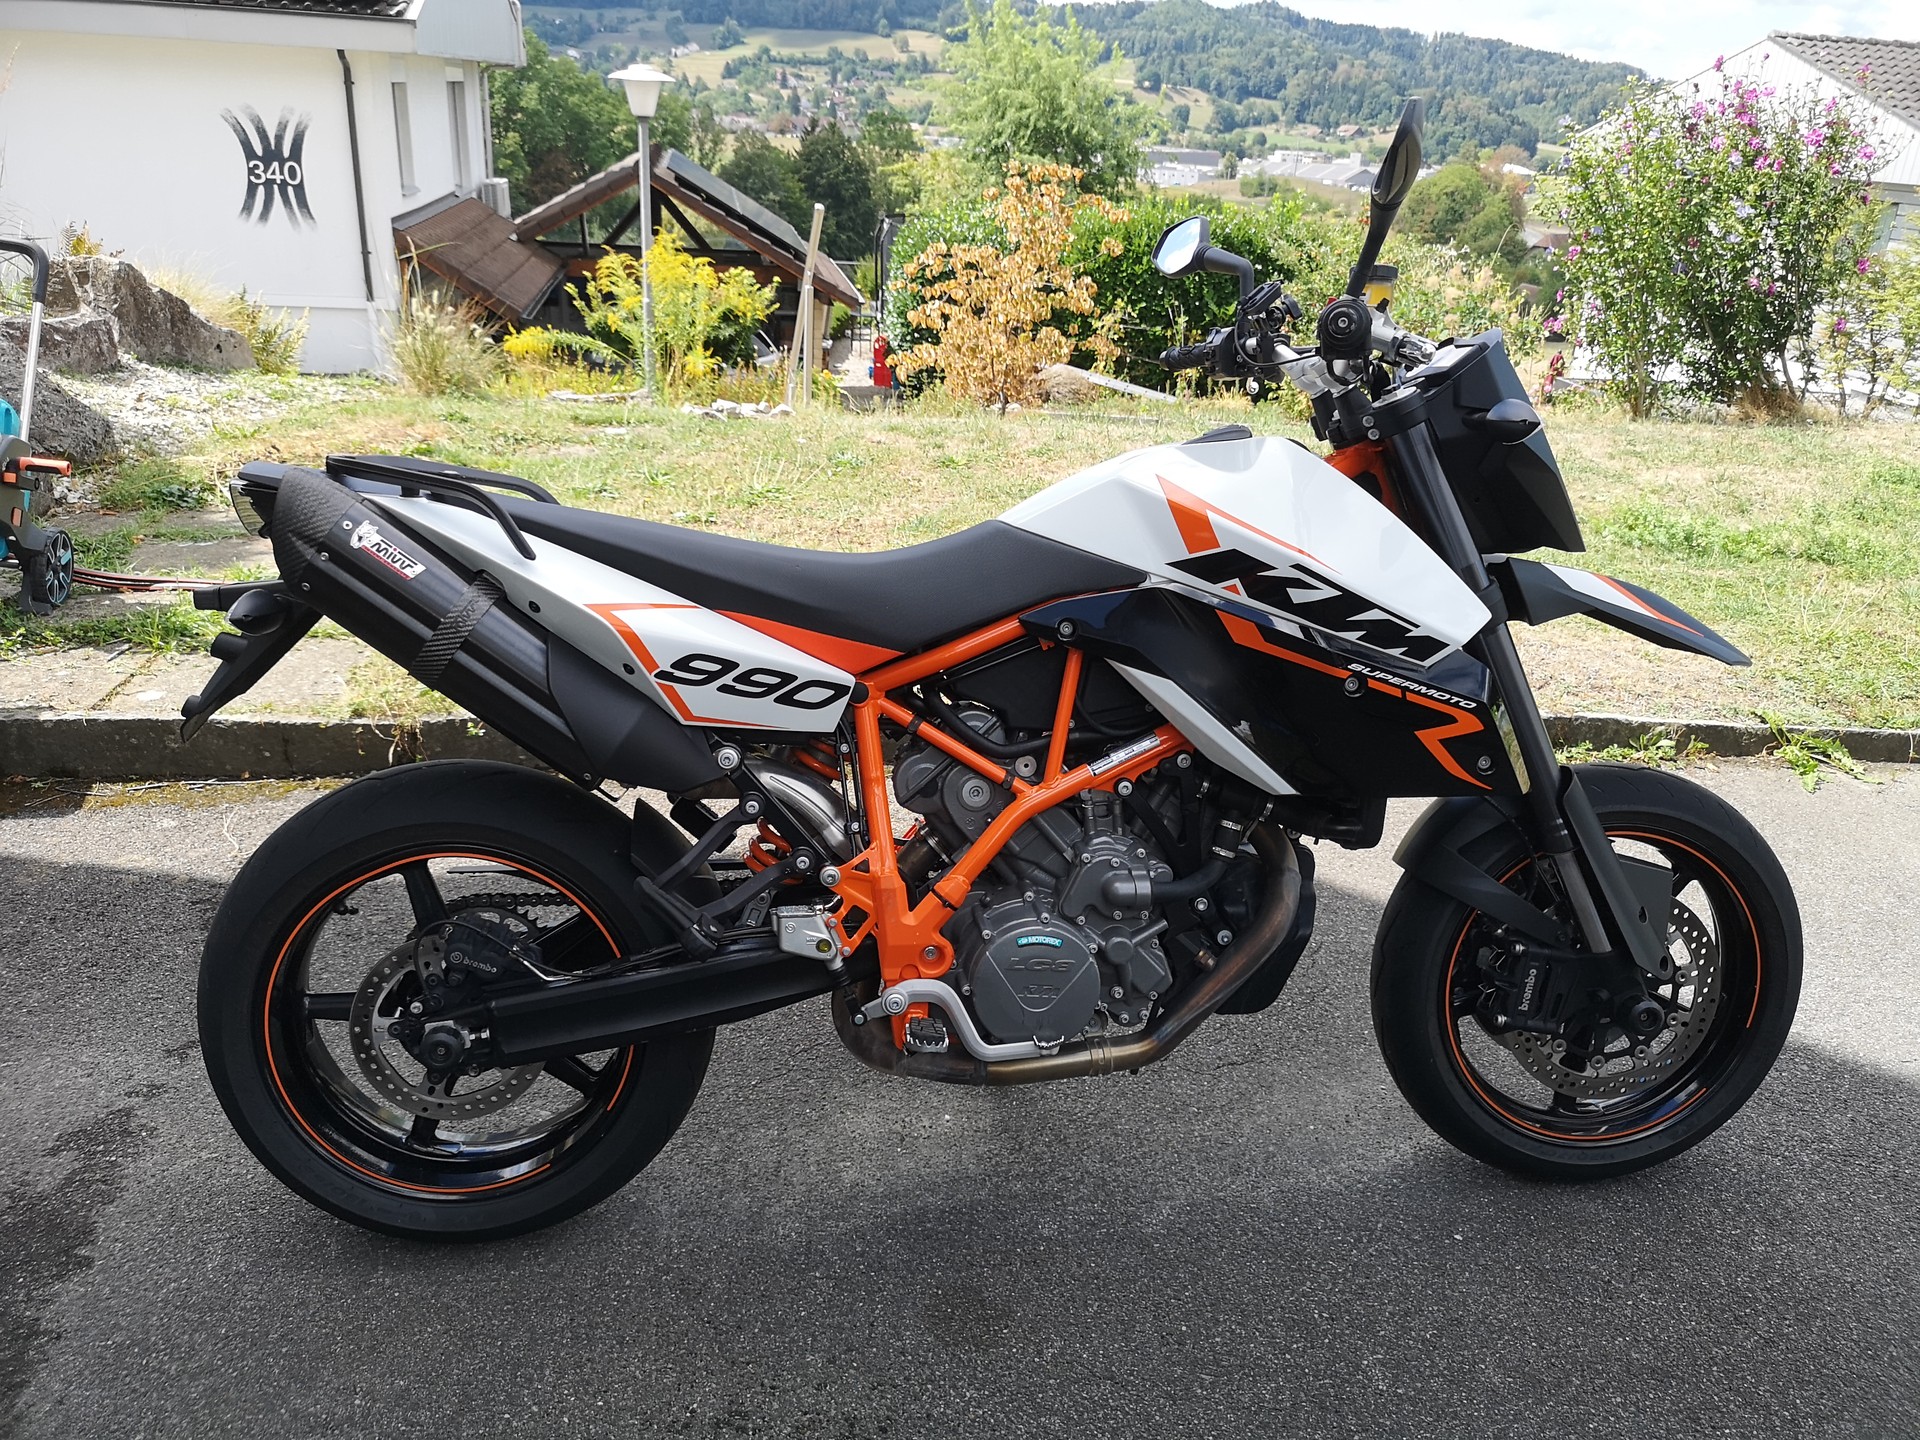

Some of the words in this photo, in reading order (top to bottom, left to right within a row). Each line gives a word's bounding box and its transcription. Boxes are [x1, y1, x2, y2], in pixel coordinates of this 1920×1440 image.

[249, 160, 302, 185] 340
[1164, 548, 1452, 664] KTM
[653, 653, 852, 710] 990
[1347, 663, 1478, 709] SUPERMOTO
[1028, 935, 1060, 945] MOTOREX
[463, 956, 498, 973] brembo
[1518, 968, 1538, 1011] brembo
